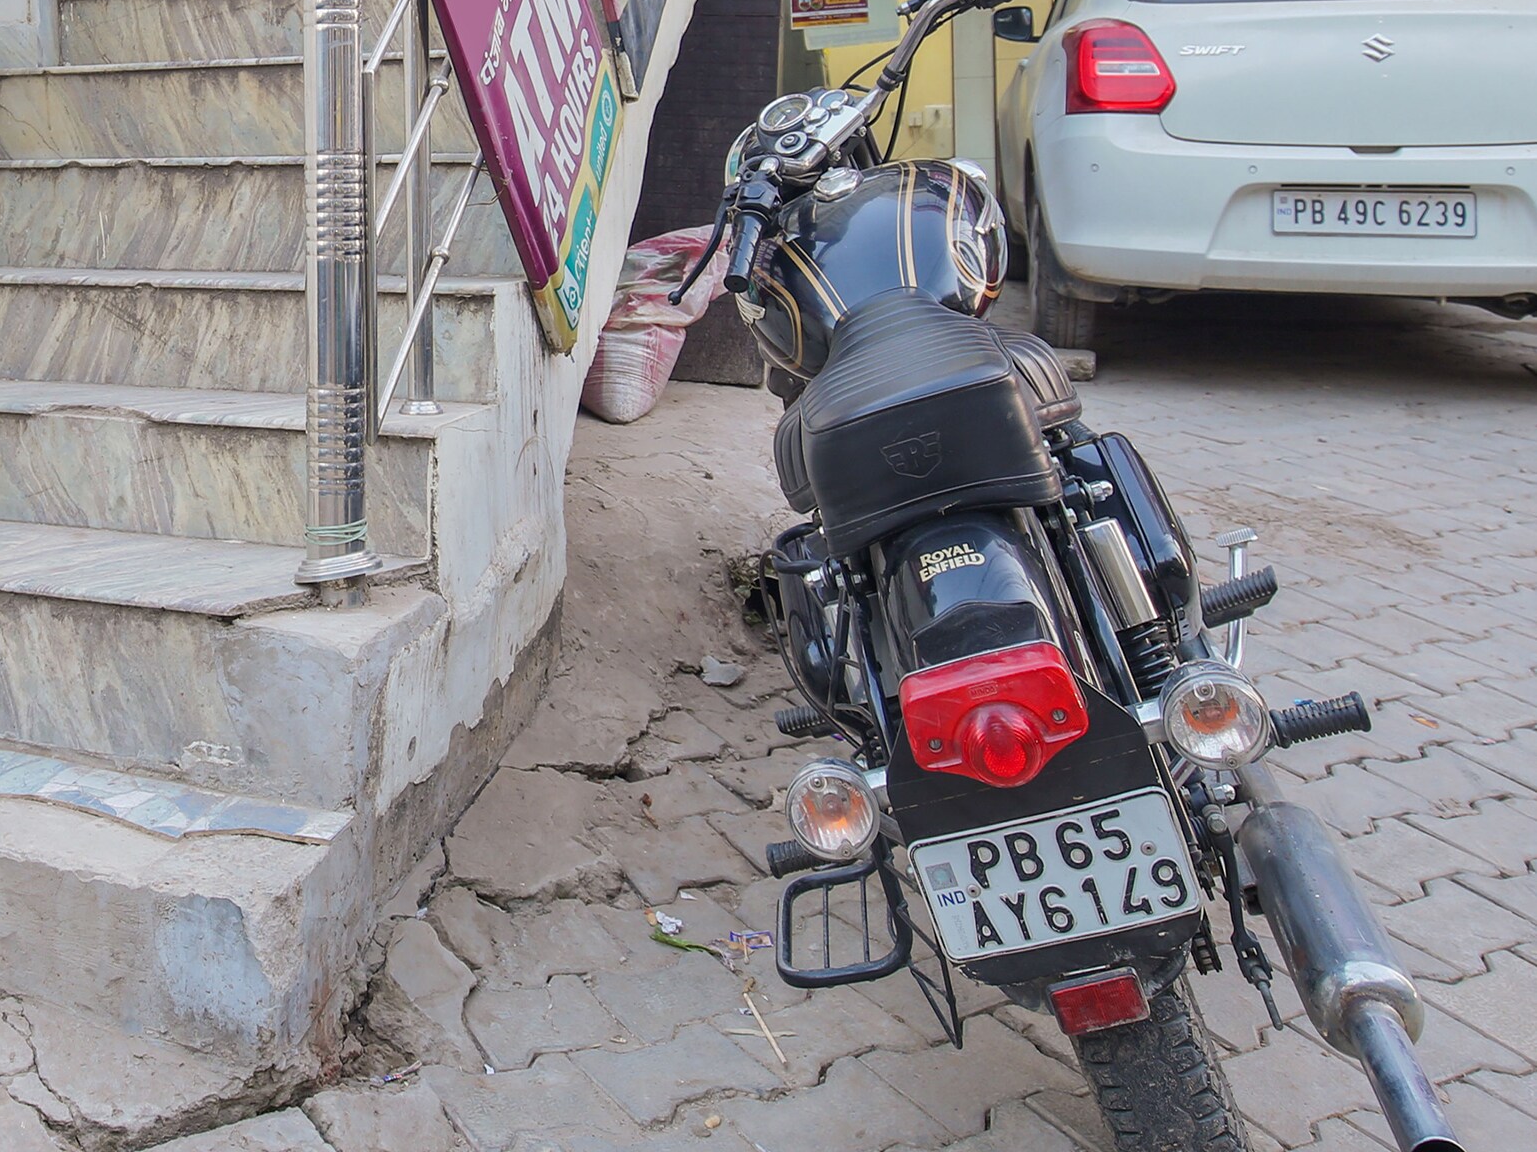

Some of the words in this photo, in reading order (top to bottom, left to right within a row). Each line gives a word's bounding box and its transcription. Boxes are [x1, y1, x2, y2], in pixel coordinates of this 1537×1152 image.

[480, 6, 505, 86] पंजाब
[1179, 45, 1247, 56] SWIFT
[551, 27, 597, 190] HOURS
[543, 172, 566, 258] 24
[1276, 208, 1292, 216] IND
[1294, 199, 1325, 225] PB
[1337, 200, 1387, 226] 49C
[1398, 200, 1467, 227] 6239
[918, 552, 986, 583] ENFIELD
[919, 543, 975, 568] ROYAL
[967, 831, 1045, 889] PB
[1055, 809, 1133, 870] 65
[937, 890, 966, 908] IND
[972, 858, 1189, 949] AY6149
